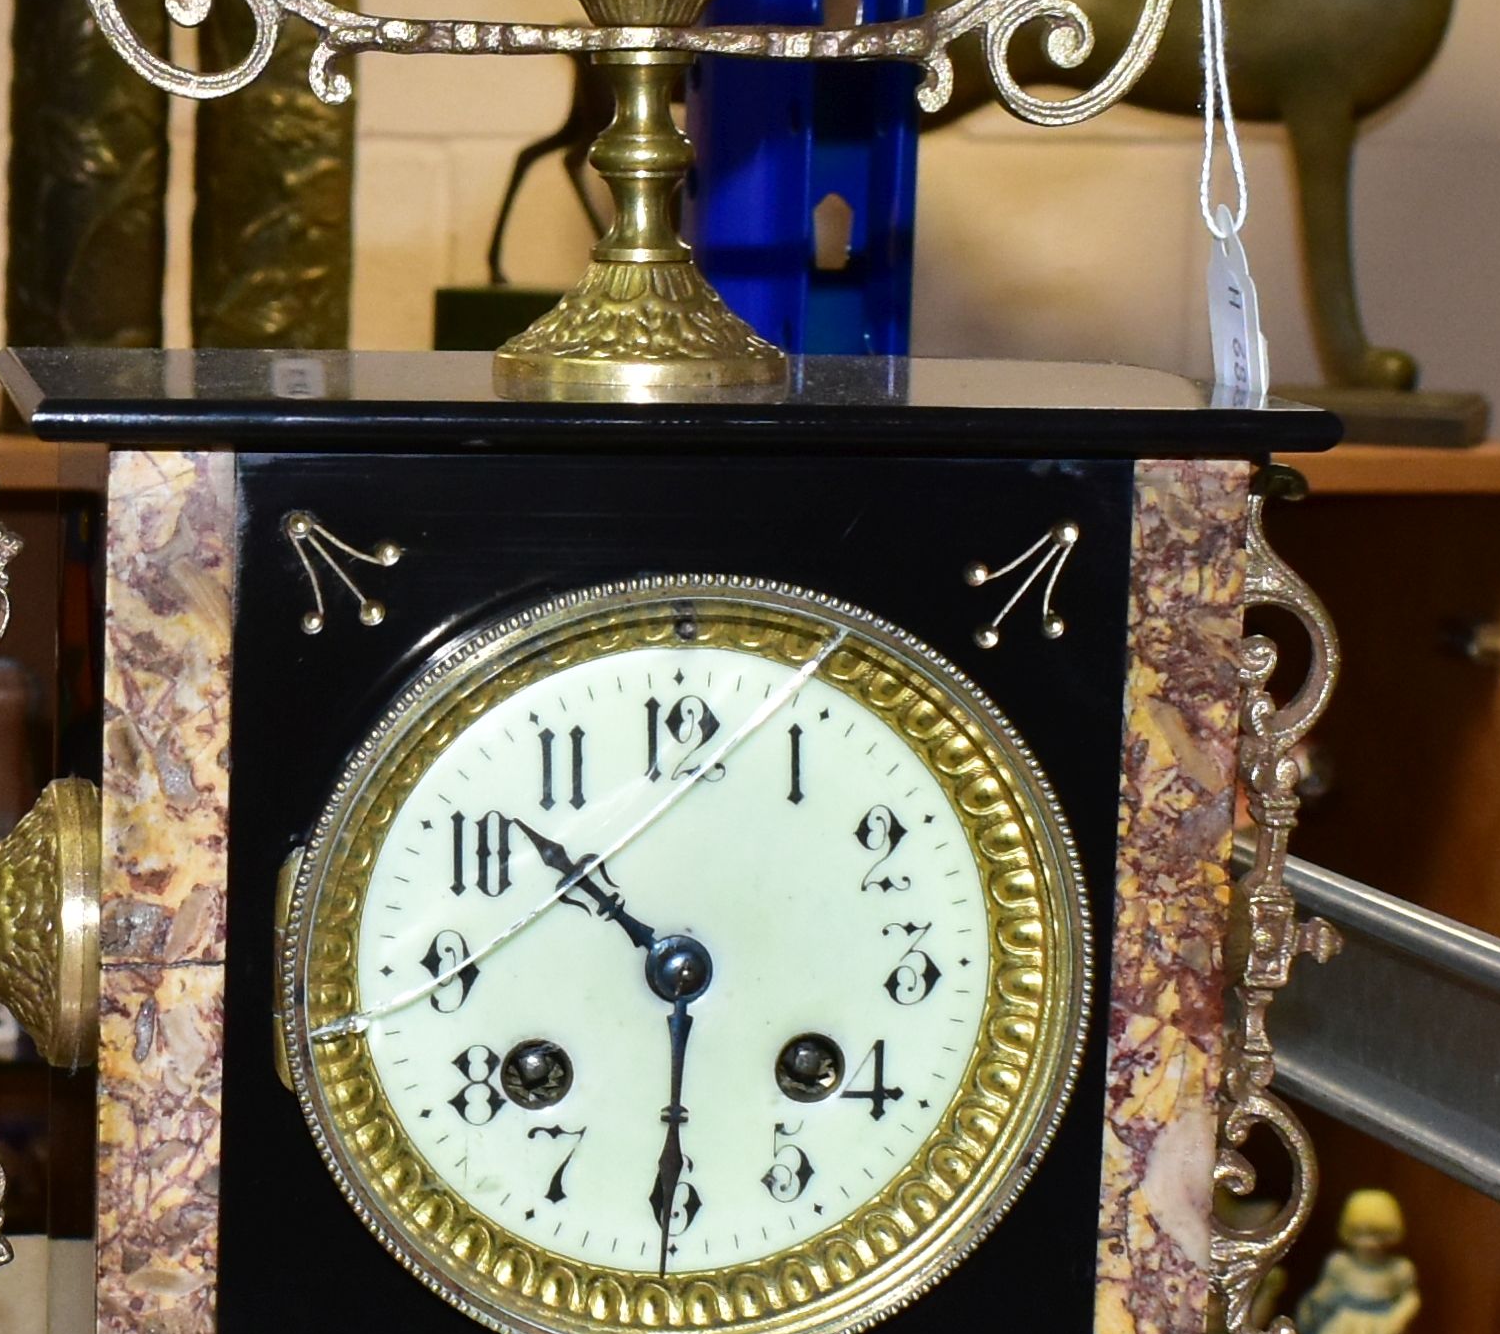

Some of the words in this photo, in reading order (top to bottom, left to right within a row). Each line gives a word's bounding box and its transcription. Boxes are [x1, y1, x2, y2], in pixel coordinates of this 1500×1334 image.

[537, 724, 587, 812] 11
[644, 694, 727, 783] 12
[786, 723, 806, 807] 1
[449, 809, 512, 898] 10
[852, 804, 912, 893] 2
[419, 929, 482, 1013] 9
[882, 920, 944, 1008] 3
[450, 1044, 508, 1126] 8
[840, 1039, 905, 1122] 4
[527, 1123, 588, 1205] 7
[760, 1122, 816, 1204] 5
